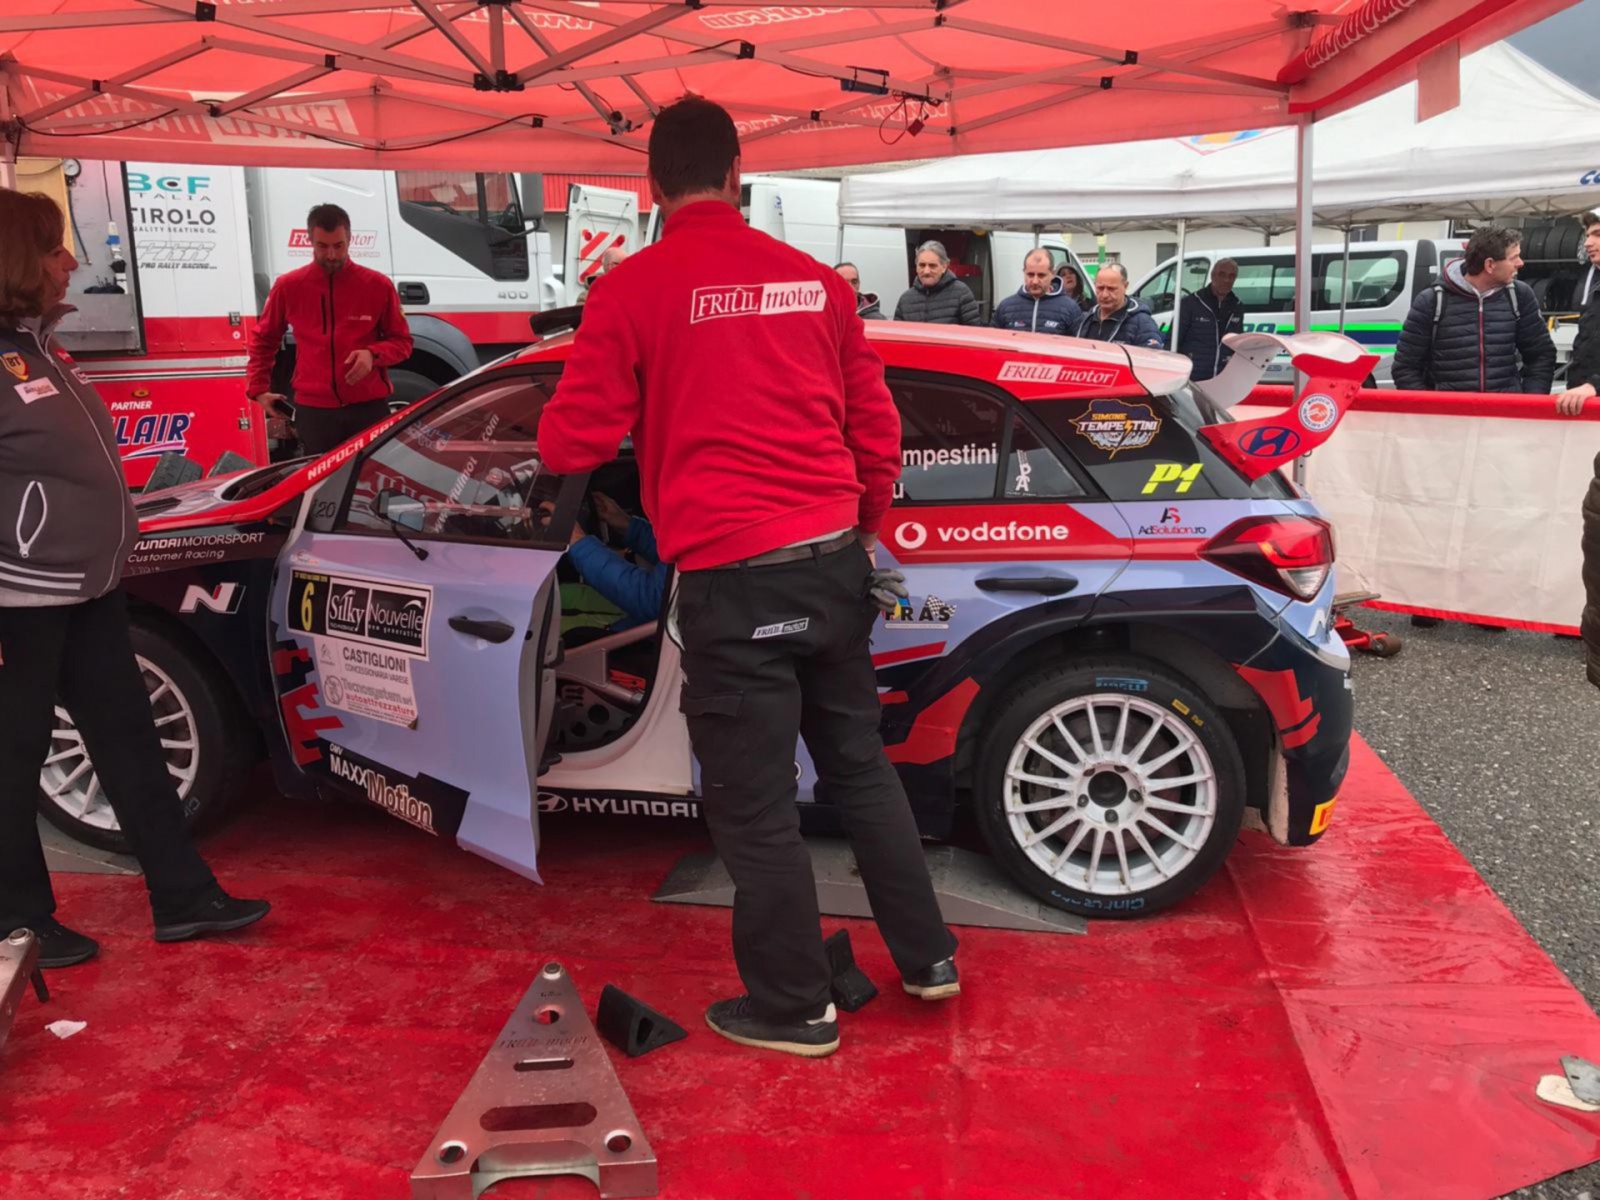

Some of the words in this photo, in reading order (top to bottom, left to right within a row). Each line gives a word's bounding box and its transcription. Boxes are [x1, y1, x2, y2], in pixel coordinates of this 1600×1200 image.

[127, 172, 210, 194] BCF
[136, 192, 211, 202] TALIA
[168, 226, 205, 234] SEATING
[497, 291, 529, 299] 400
[765, 286, 824, 310] motor
[1058, 368, 1115, 384] motor
[111, 401, 152, 411] PARTNER
[113, 413, 190, 446] LAIR
[307, 438, 364, 480] NAPOCA
[903, 443, 997, 471] mpestini
[1141, 463, 1204, 494] P1
[937, 521, 1069, 542] vodafone
[127, 552, 182, 563] Customer
[185, 549, 225, 560] Racing
[301, 581, 314, 632] 6
[328, 591, 365, 631] Silky
[368, 602, 424, 631] Nouvelle
[343, 647, 406, 673] CASTIGLIONI
[345, 693, 416, 717] autoattrezzature
[573, 797, 698, 818] HYUNDAI
